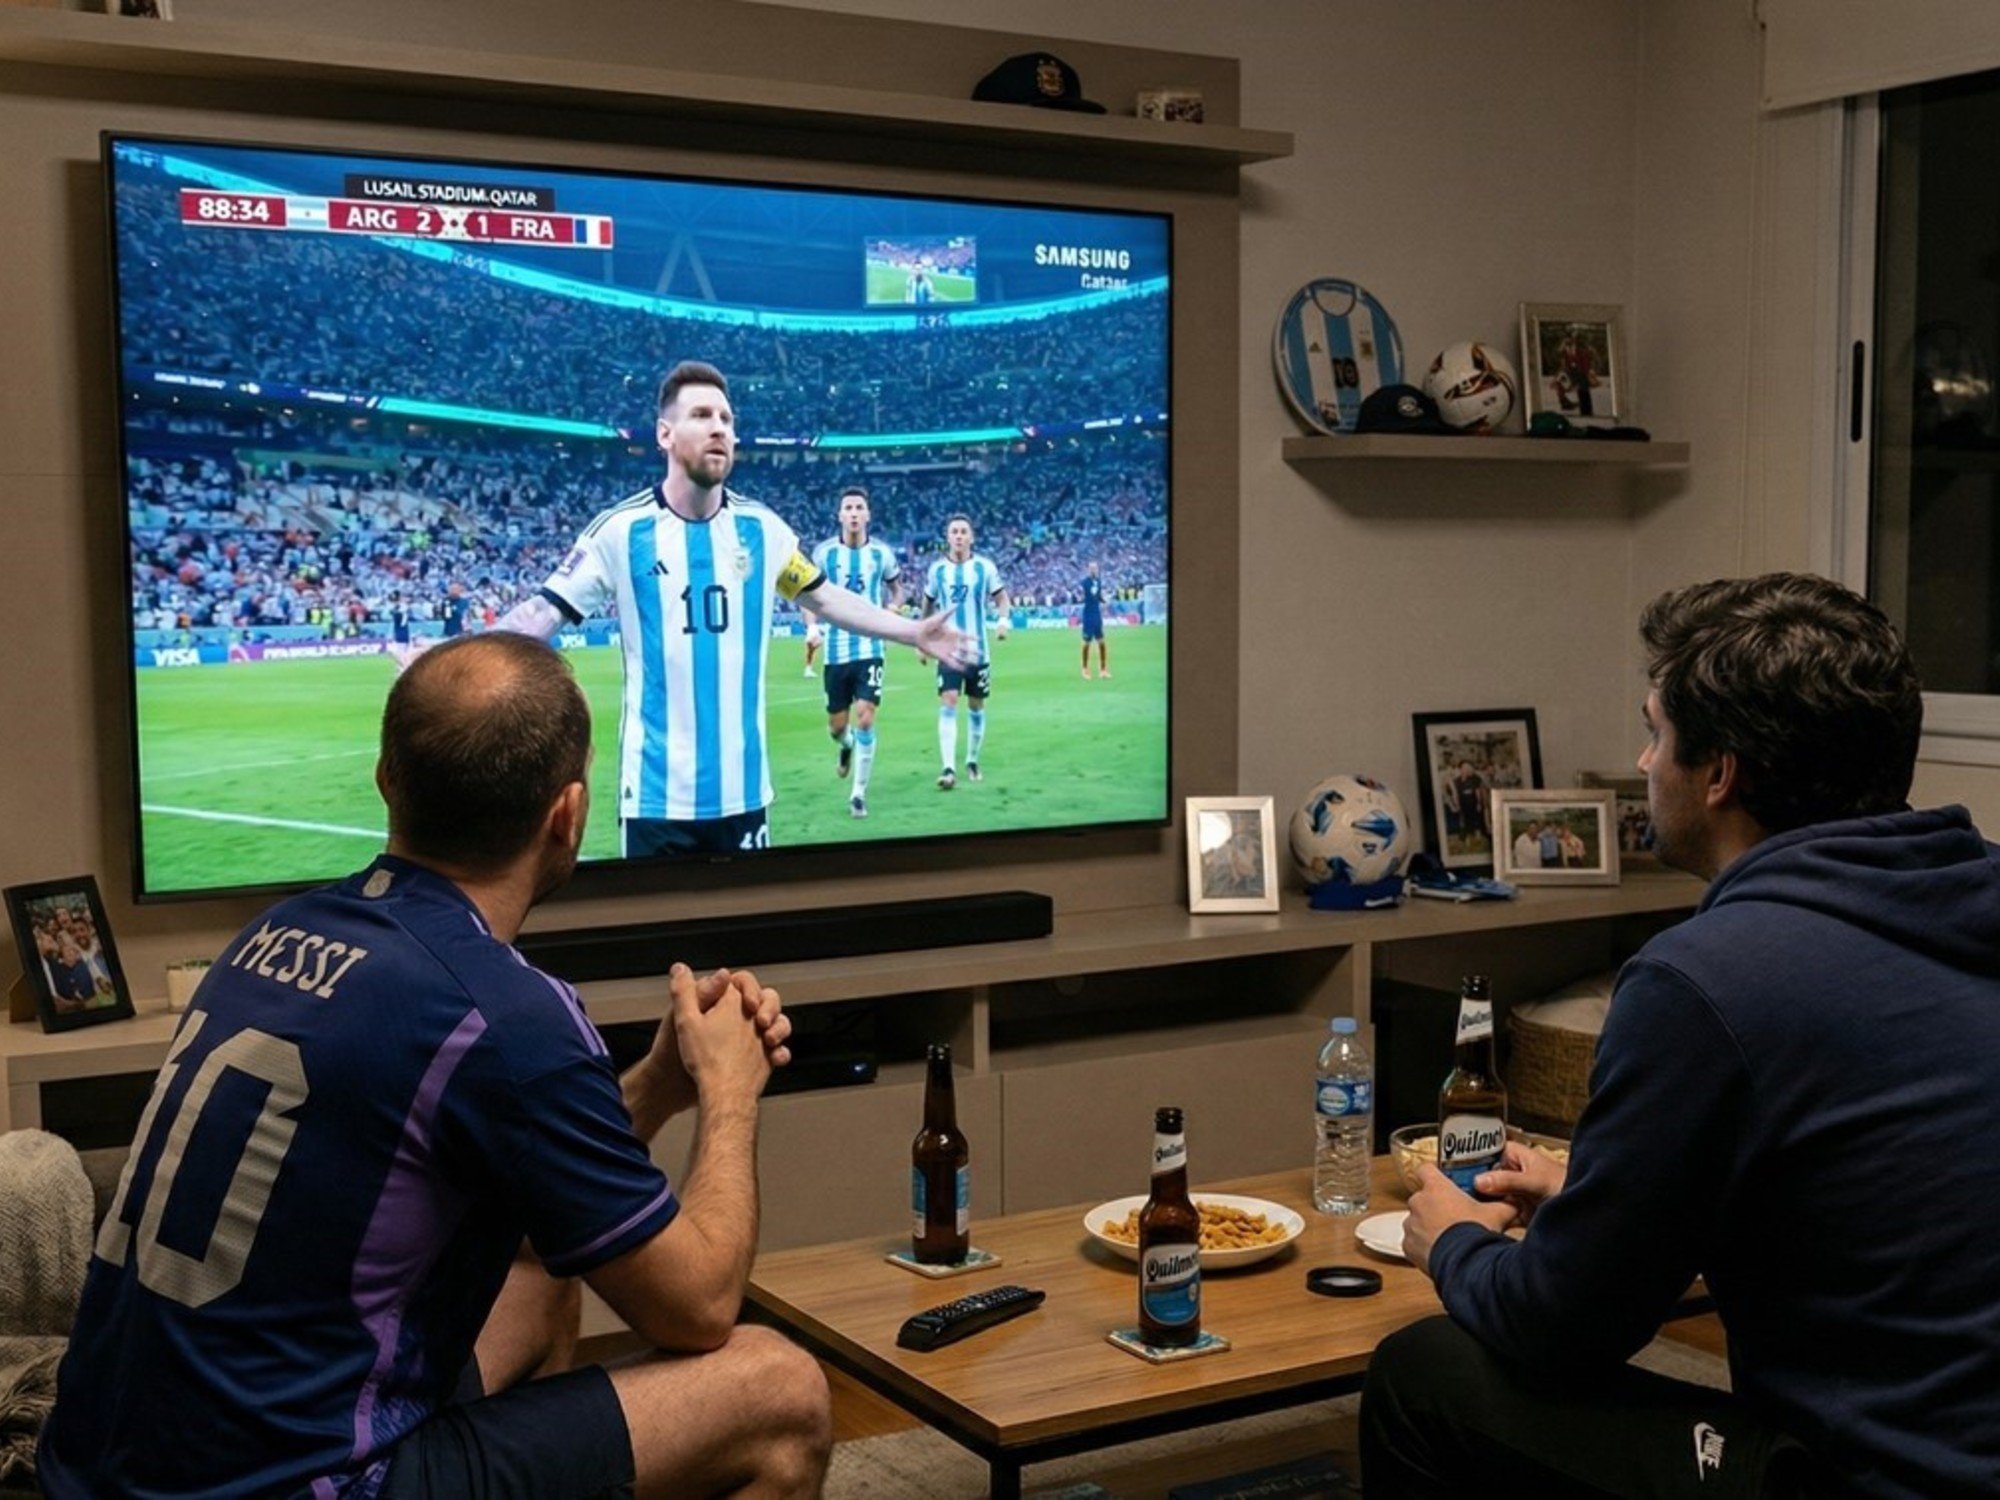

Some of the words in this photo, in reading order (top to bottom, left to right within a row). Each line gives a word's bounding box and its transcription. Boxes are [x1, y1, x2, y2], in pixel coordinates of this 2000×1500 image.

[198, 197, 270, 222] 88:34
[347, 206, 397, 229] ARG
[416, 211, 432, 232] 2
[477, 215, 488, 235] 1
[511, 218, 555, 239] FRA
[491, 190, 538, 207] QATAR
[1035, 243, 1130, 270] SAMSUNG
[680, 584, 729, 635] 10
[152, 648, 201, 667] VISA
[231, 919, 367, 999] MESSI
[95, 1009, 309, 1308] 10
